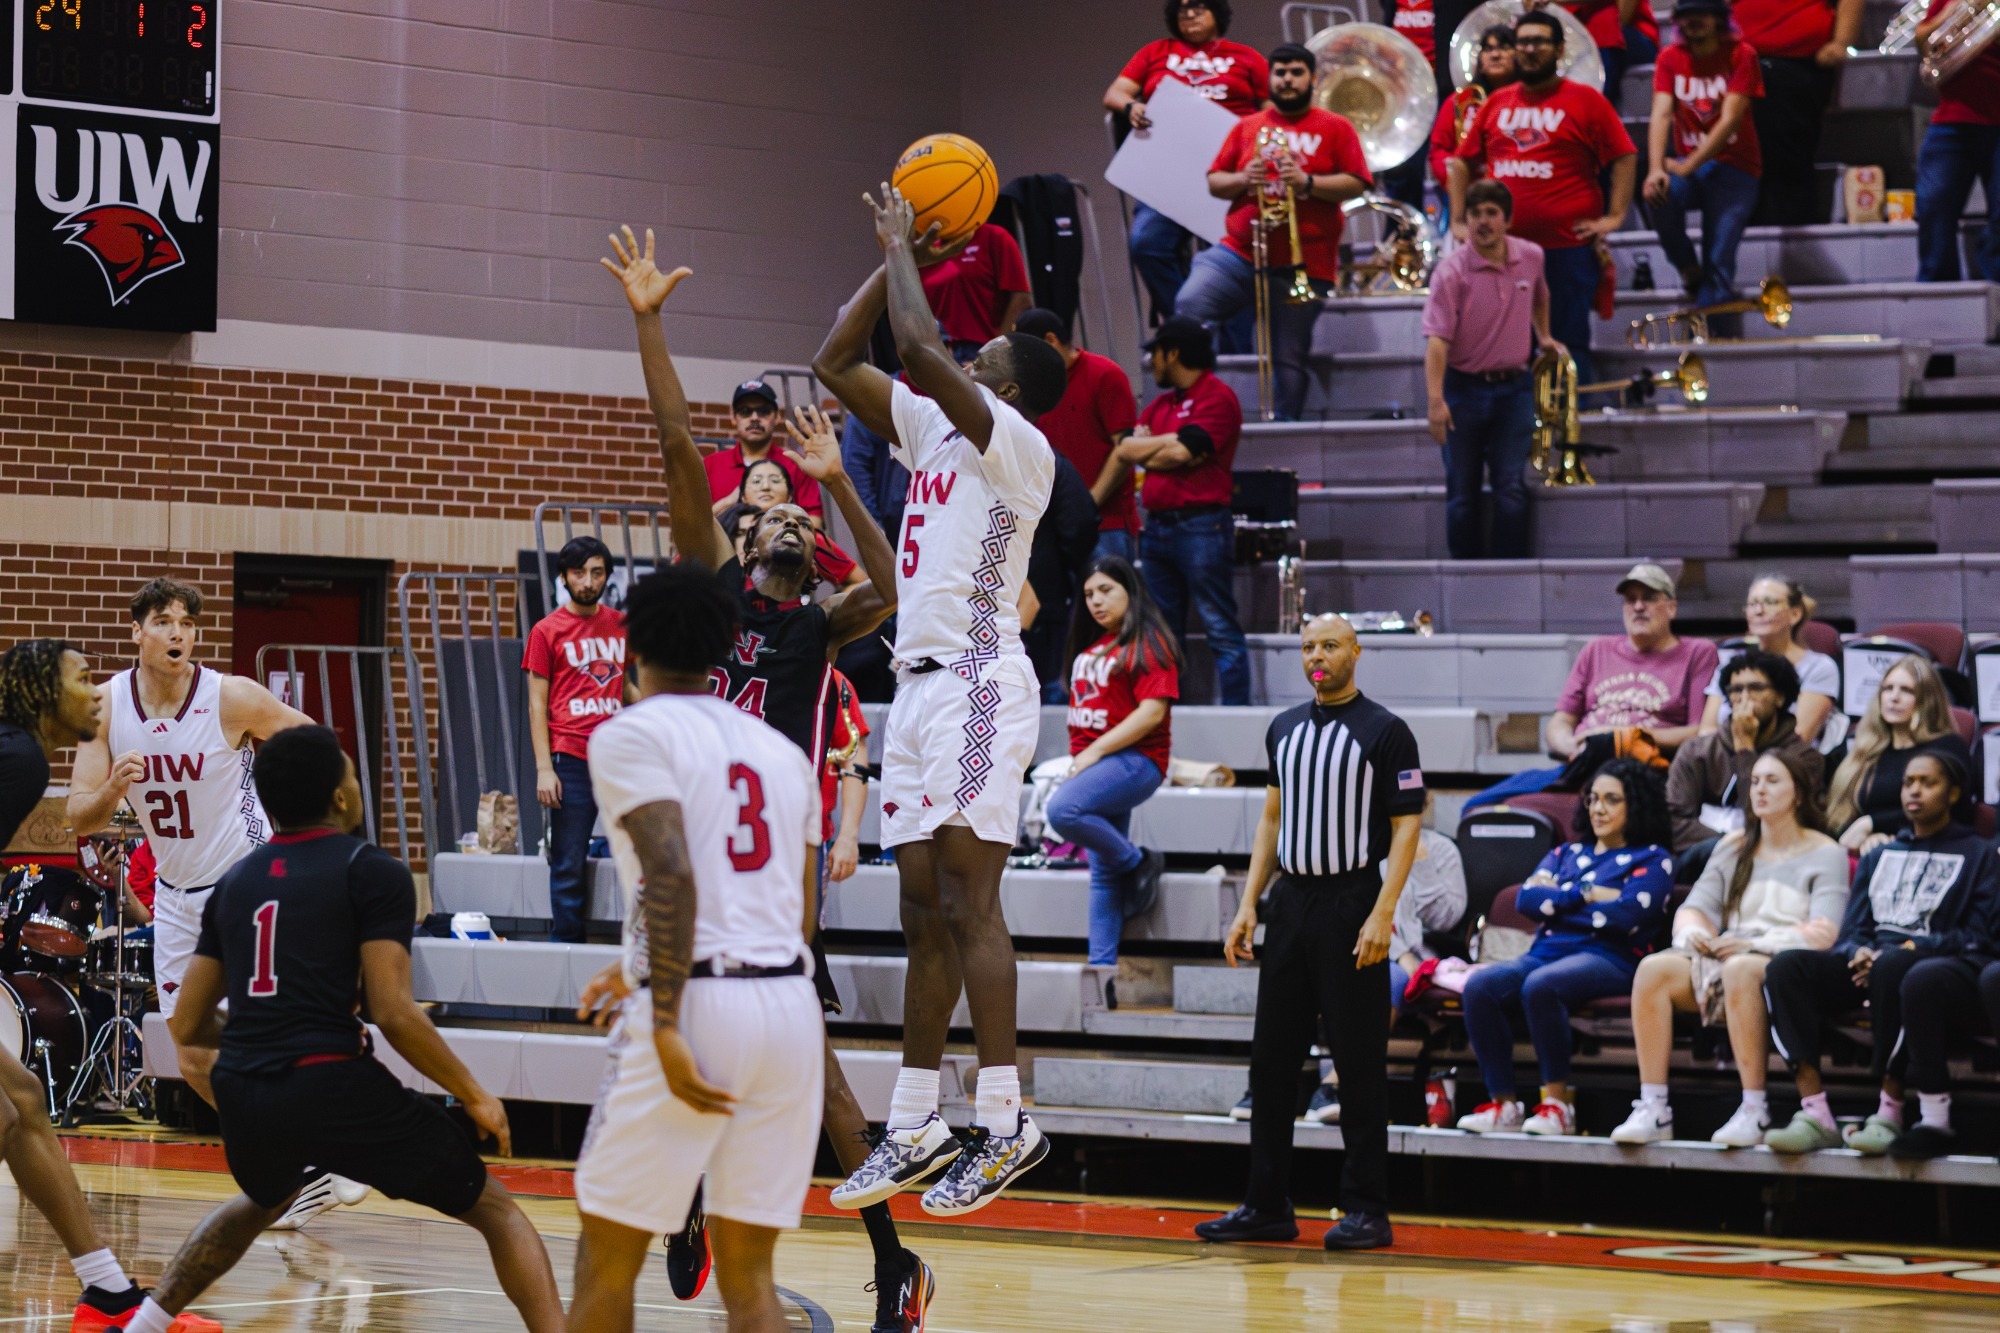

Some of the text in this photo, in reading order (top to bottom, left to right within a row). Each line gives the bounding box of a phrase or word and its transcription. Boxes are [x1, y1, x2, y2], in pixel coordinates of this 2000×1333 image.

[187, 5, 207, 48] 2
[1497, 107, 1565, 132] UIW
[30, 124, 212, 223] UIW
[902, 514, 925, 579] 5
[563, 636, 626, 668] UIW
[144, 790, 195, 839] 21
[727, 762, 771, 872] 3
[248, 899, 279, 997] 1
